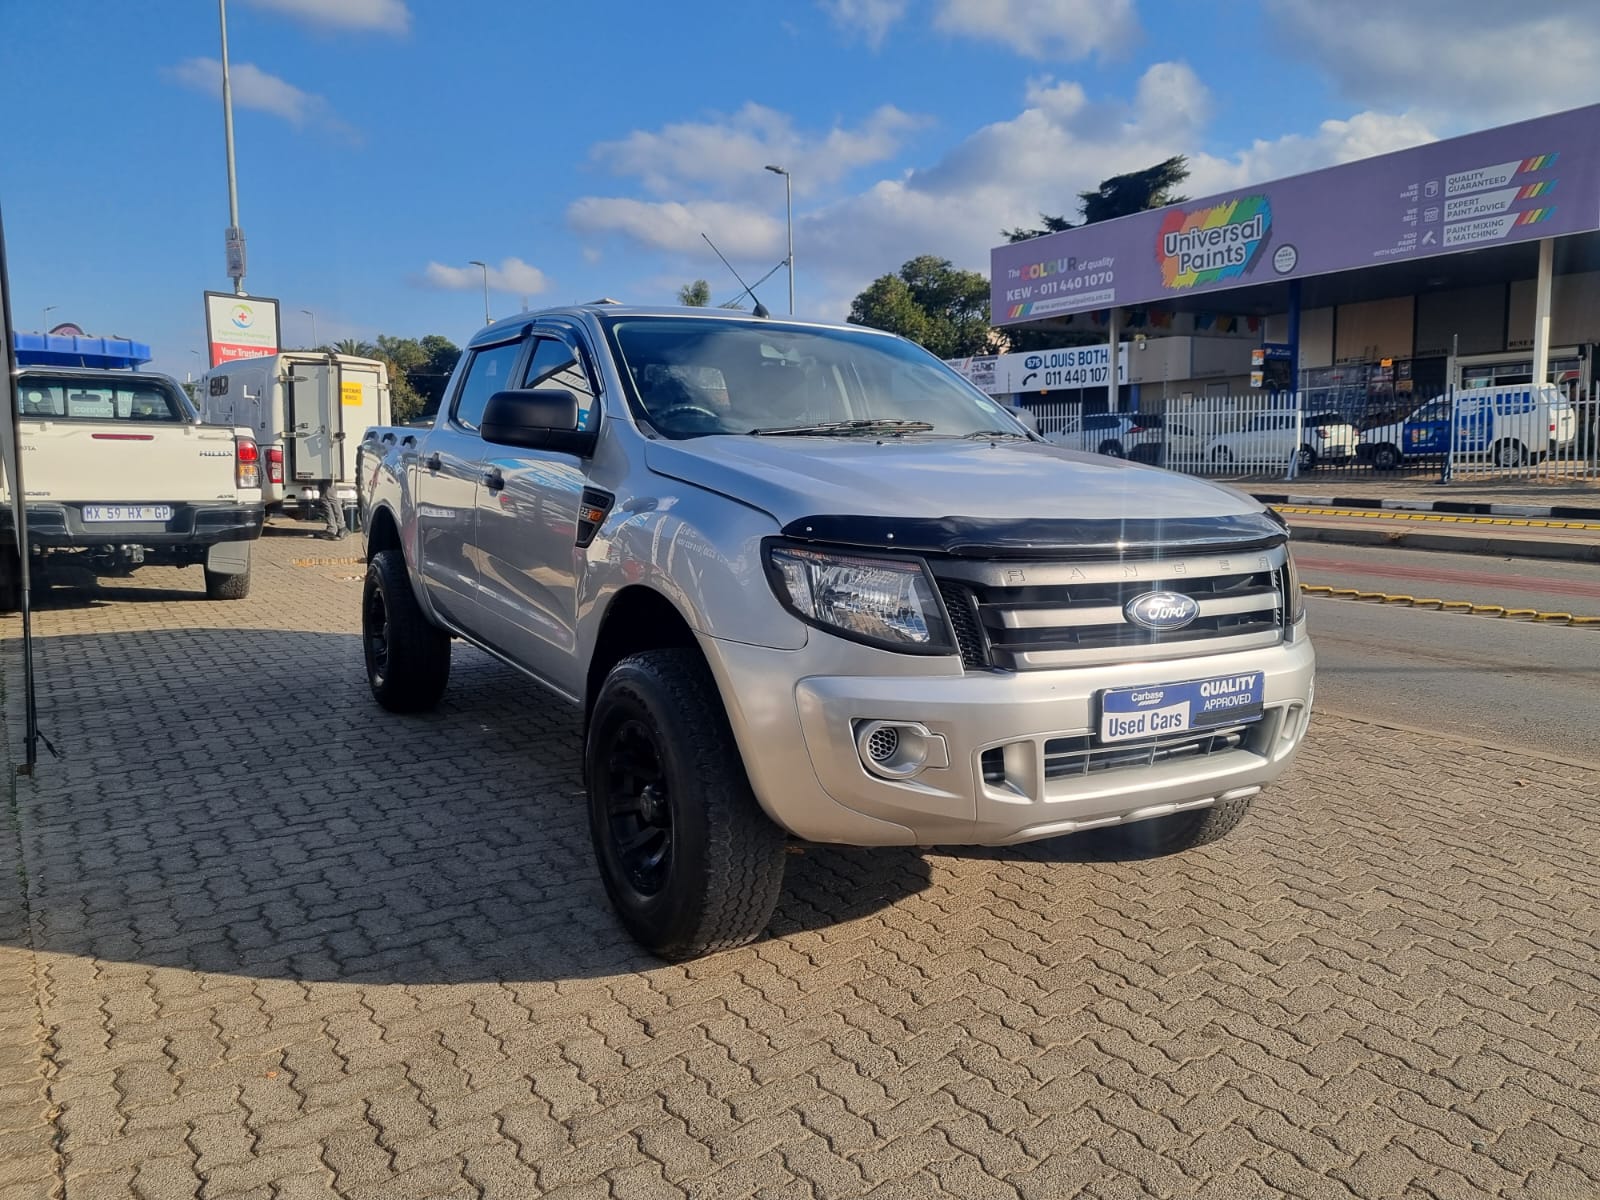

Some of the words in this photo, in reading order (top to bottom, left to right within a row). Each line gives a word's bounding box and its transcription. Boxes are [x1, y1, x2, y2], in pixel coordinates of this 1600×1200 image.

[1447, 176, 1507, 193] GUARANTEED
[1448, 172, 1484, 186] QUALITY
[1447, 198, 1479, 210] EXPERT
[1447, 207, 1472, 218] PAINT
[1474, 201, 1506, 213] ADVICE
[1165, 214, 1262, 255] Universal
[1446, 225, 1471, 235] PAINT
[1473, 219, 1504, 230] MIXING
[1453, 229, 1498, 242] MATCHING
[1180, 244, 1245, 273] Paints
[1008, 268, 1020, 279] The
[1021, 257, 1077, 280] COLOUR
[1078, 260, 1087, 271] of
[1087, 256, 1115, 270] quality
[1006, 286, 1032, 301] KEW
[1040, 281, 1058, 295] 011
[1060, 277, 1082, 291] 440
[1084, 271, 1114, 287] 1070
[221, 346, 237, 357] Your
[1043, 352, 1075, 369] LOUIS
[1078, 349, 1110, 366] BOTH
[1027, 358, 1040, 368] 575
[1045, 370, 1062, 386] 011
[1064, 369, 1087, 384] 440
[106, 506, 121, 519] 59
[128, 506, 142, 519] HX
[154, 506, 169, 519] GP
[1007, 556, 1271, 582] RANGER
[1147, 595, 1187, 620] Ford
[1200, 675, 1256, 698] QUALITY
[1131, 690, 1164, 702] Carbase
[1204, 693, 1252, 711] APPROVED
[1109, 714, 1146, 737] Used
[1150, 712, 1182, 732] Cars
